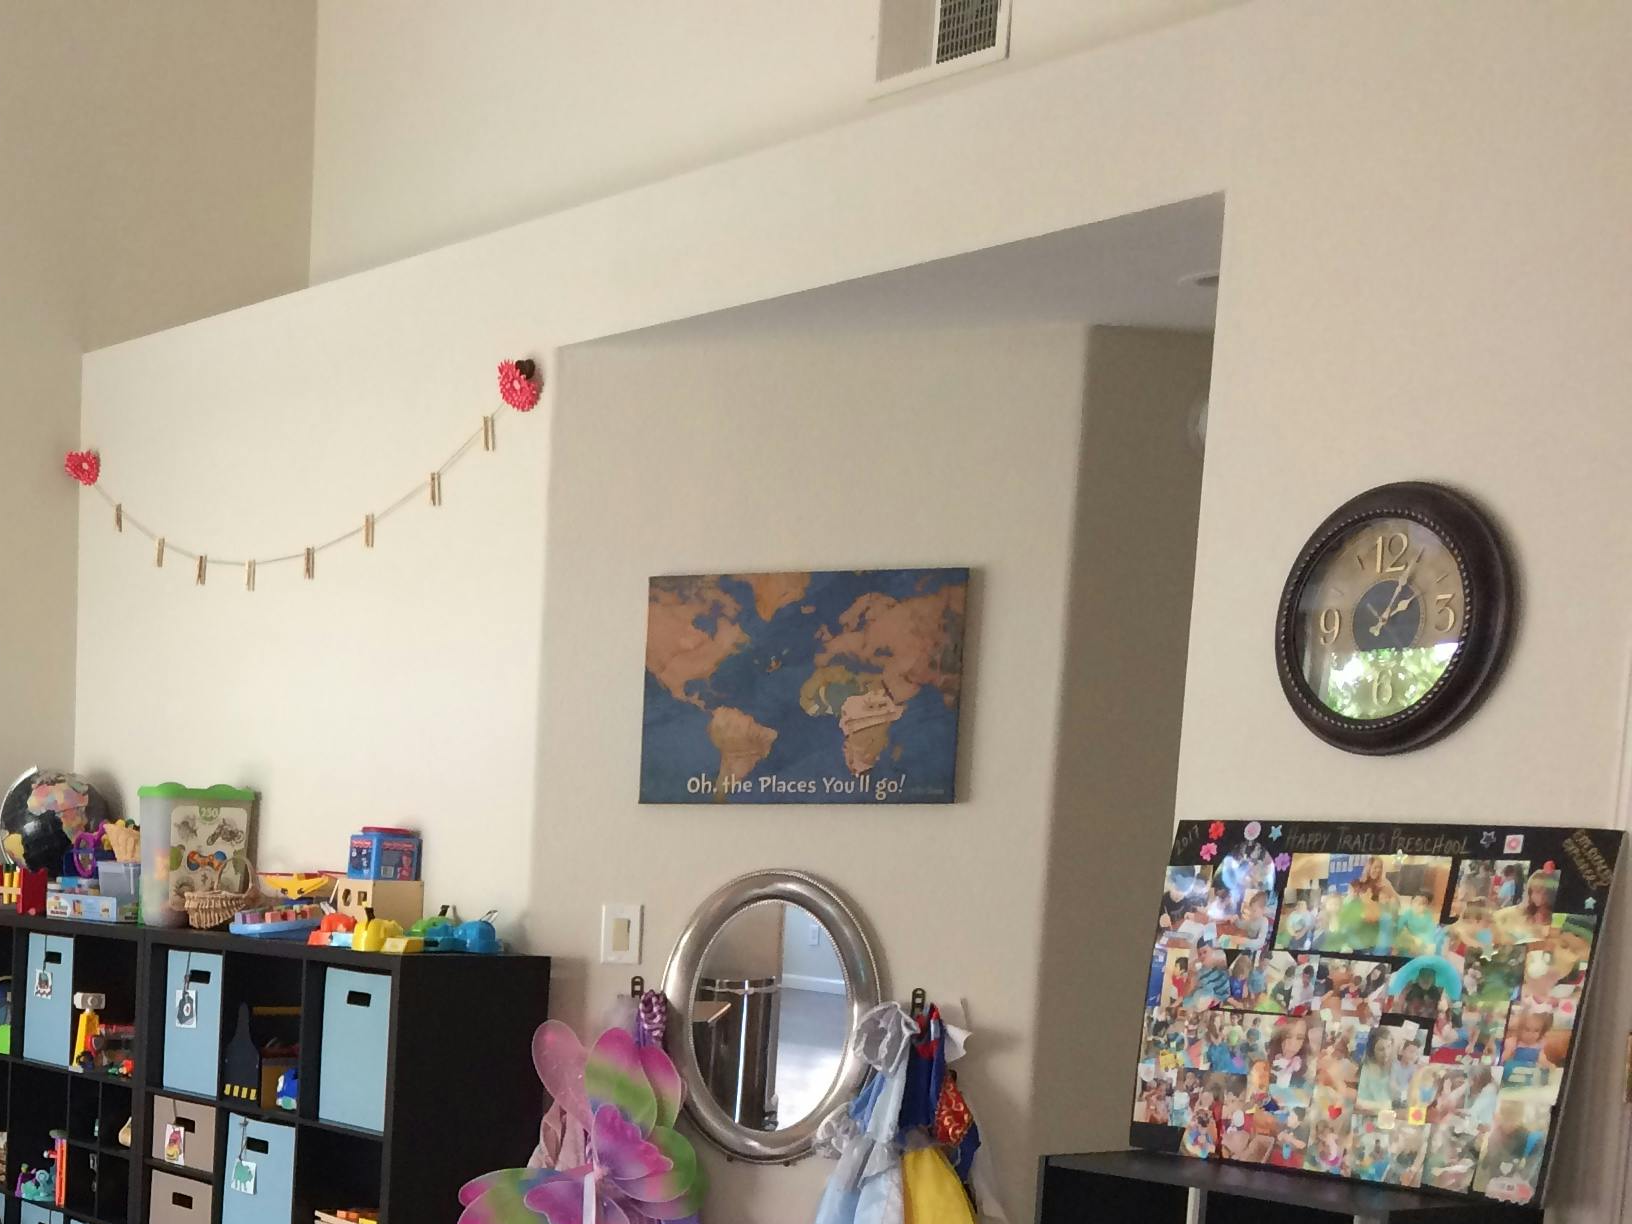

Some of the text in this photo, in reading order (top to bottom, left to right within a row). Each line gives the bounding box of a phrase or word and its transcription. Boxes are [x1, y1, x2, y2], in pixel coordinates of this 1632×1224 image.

[1374, 531, 1409, 574] 12
[1318, 607, 1342, 647] 9
[1434, 593, 1457, 633] 3
[1371, 667, 1394, 707] 6
[721, 773, 754, 794] the
[757, 775, 817, 794] Places
[822, 773, 870, 794] You'll
[874, 774, 907, 801] go!
[1285, 826, 1470, 856] HAPPY TRAILS PRESCHOOL
